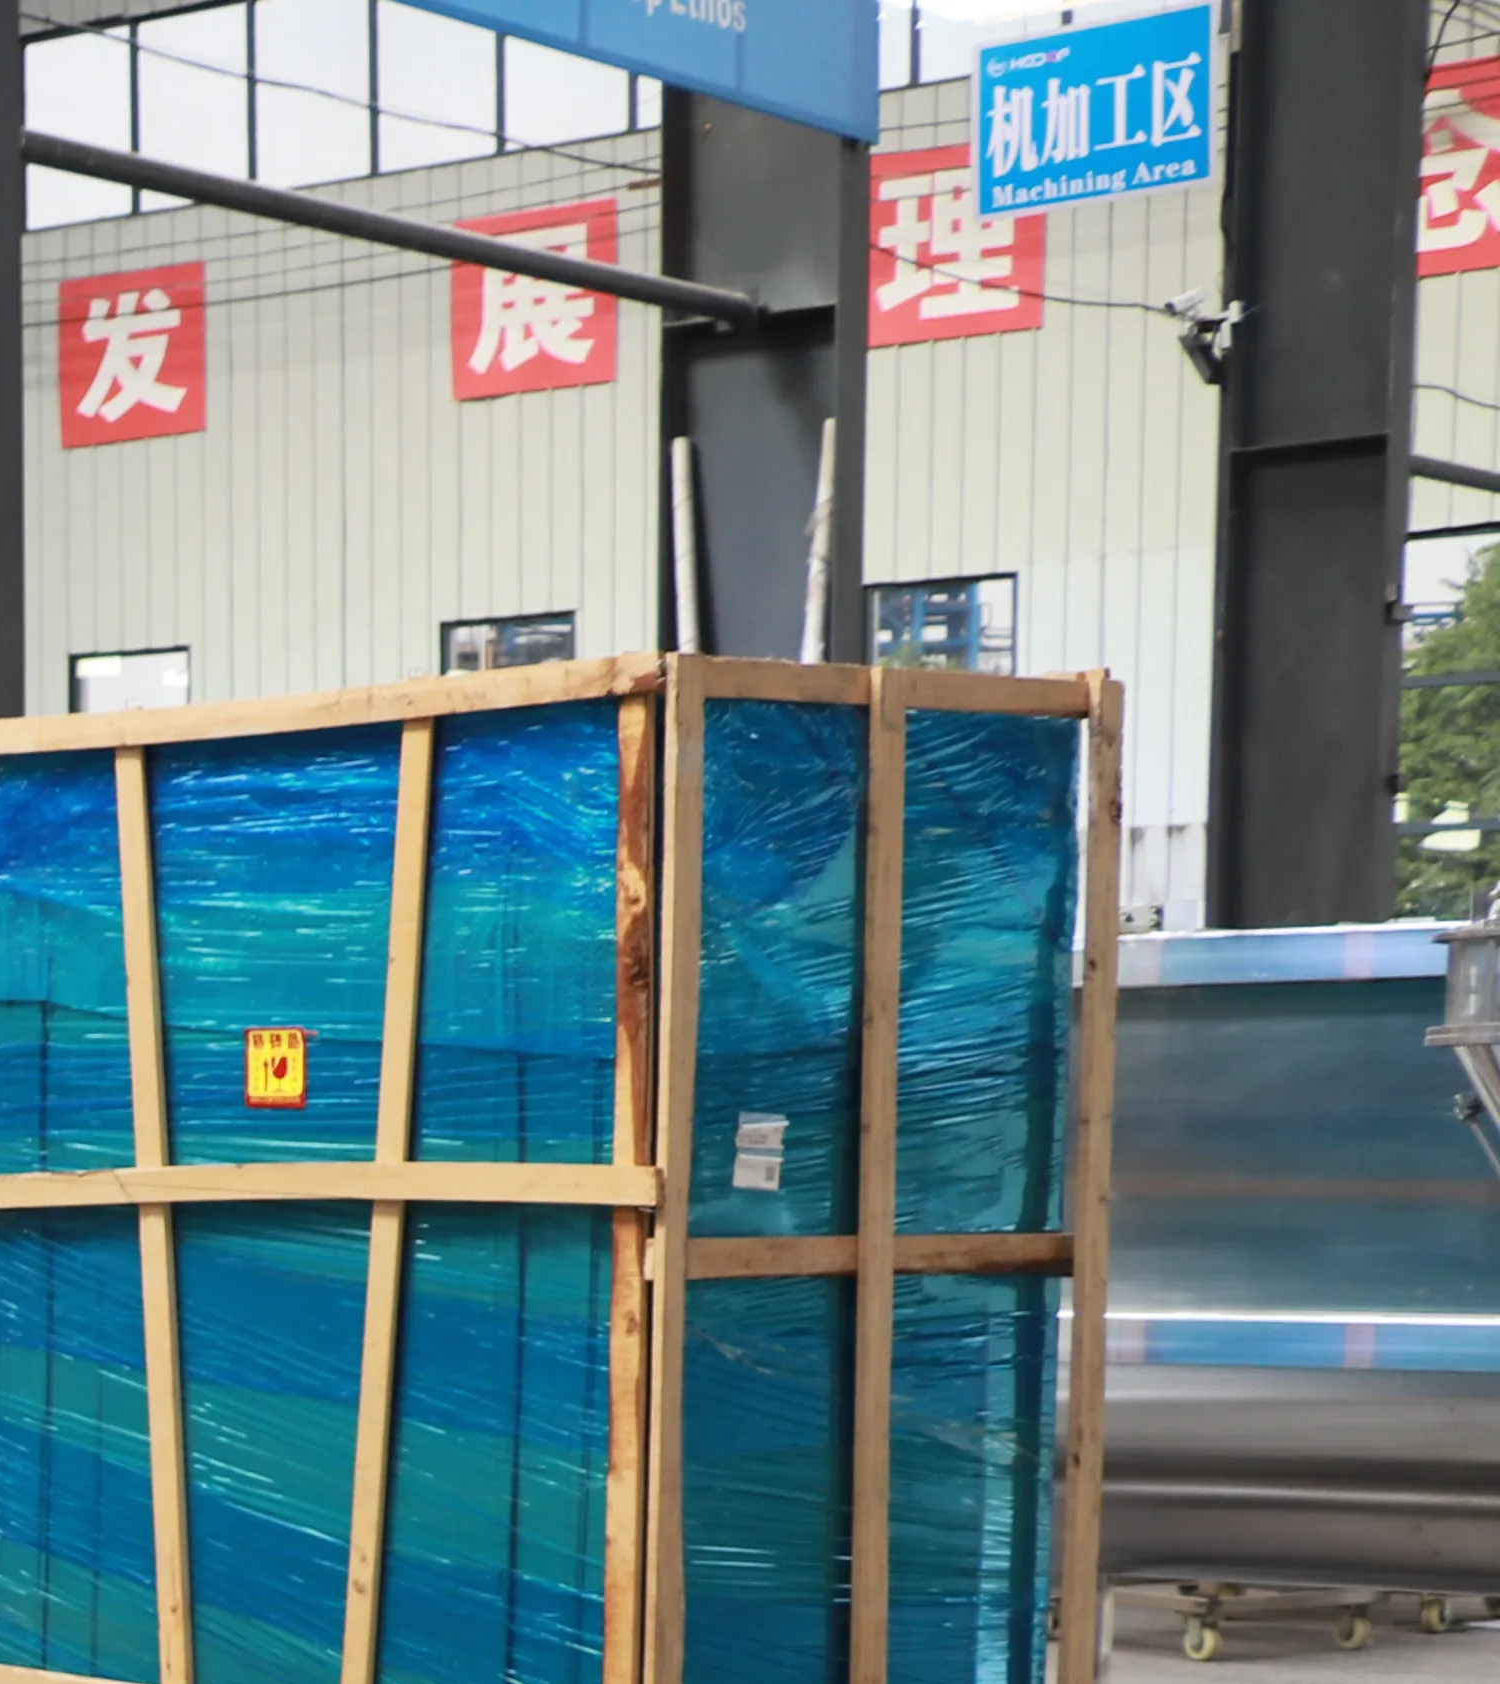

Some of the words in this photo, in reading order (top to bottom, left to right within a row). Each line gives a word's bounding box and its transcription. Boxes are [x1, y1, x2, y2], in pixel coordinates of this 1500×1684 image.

[986, 51, 1202, 178] 机加工区
[990, 167, 1127, 209] Machining
[1131, 158, 1197, 185] Area
[75, 287, 188, 424] 发
[467, 222, 596, 374] 展
[875, 167, 1020, 320] 理
